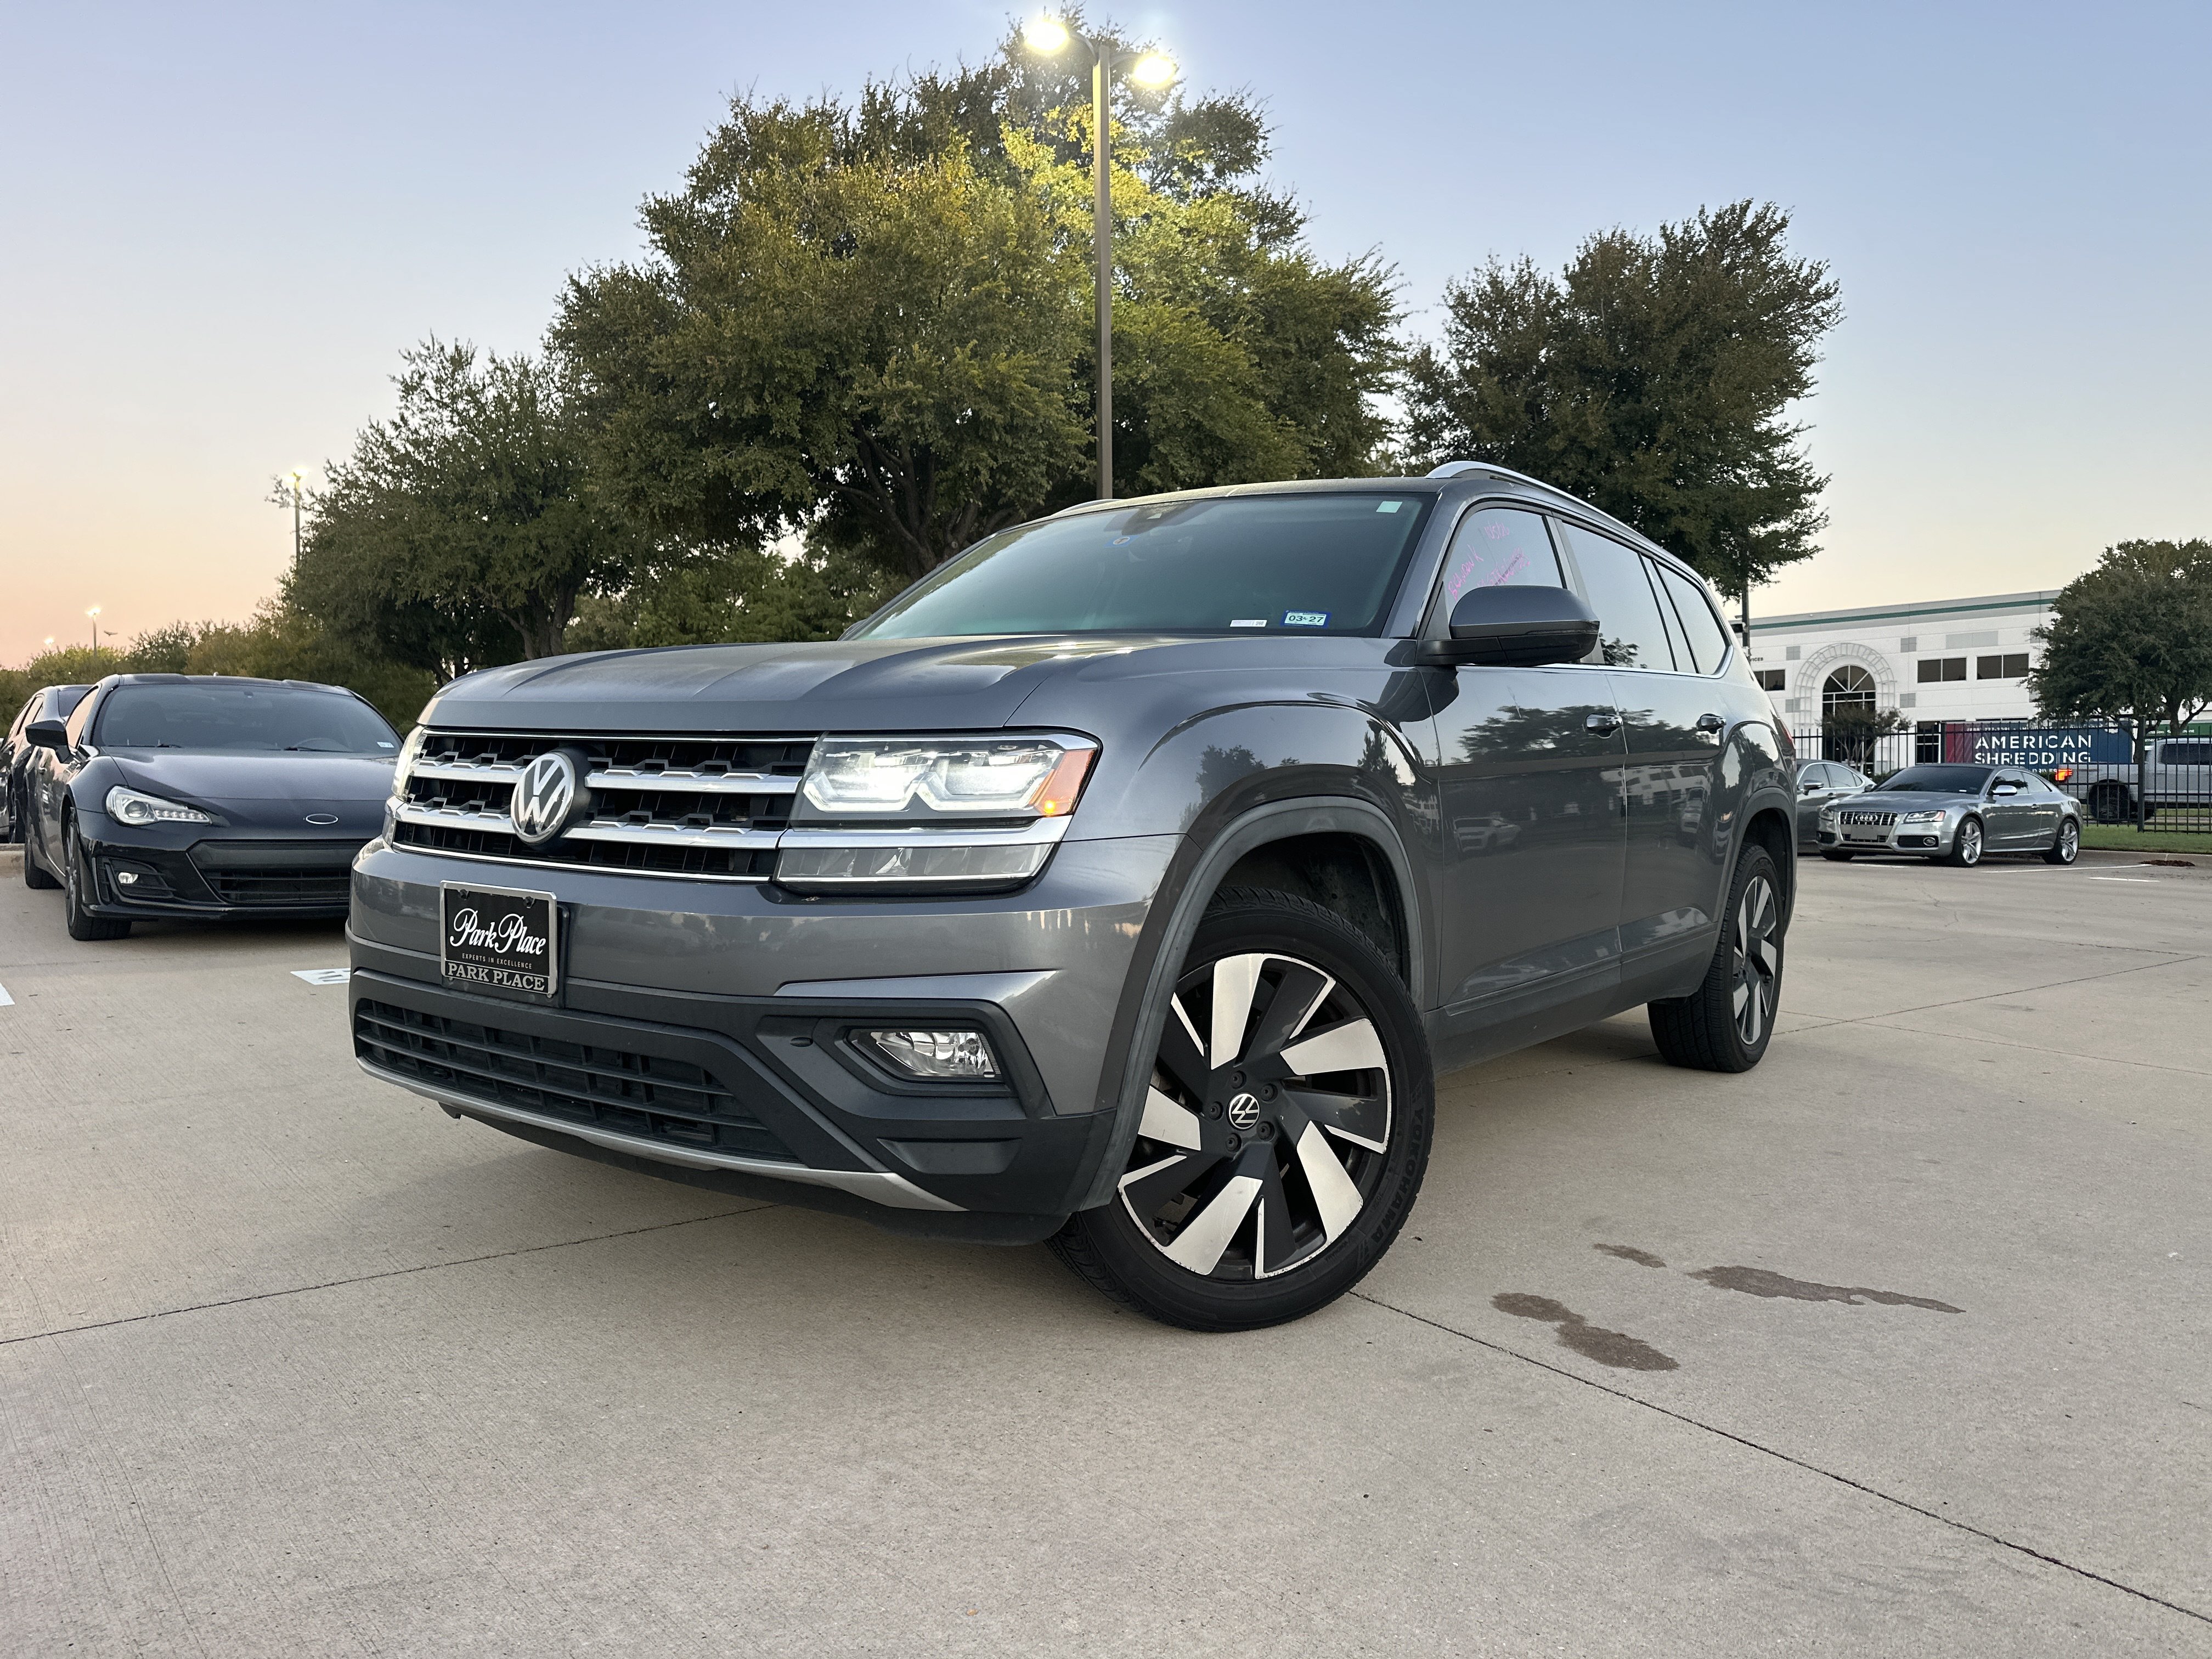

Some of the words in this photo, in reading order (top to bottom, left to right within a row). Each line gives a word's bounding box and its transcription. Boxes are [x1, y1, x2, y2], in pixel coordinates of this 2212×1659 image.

[1975, 735, 2091, 749] AMERICAN
[1975, 752, 2091, 765] SHREDDING
[450, 908, 496, 947] Park
[494, 913, 546, 955] Place
[462, 952, 486, 962] EXPERTS
[496, 958, 532, 969] EXCELLENCE
[448, 963, 489, 982] PARK
[493, 970, 545, 991] PLACE
